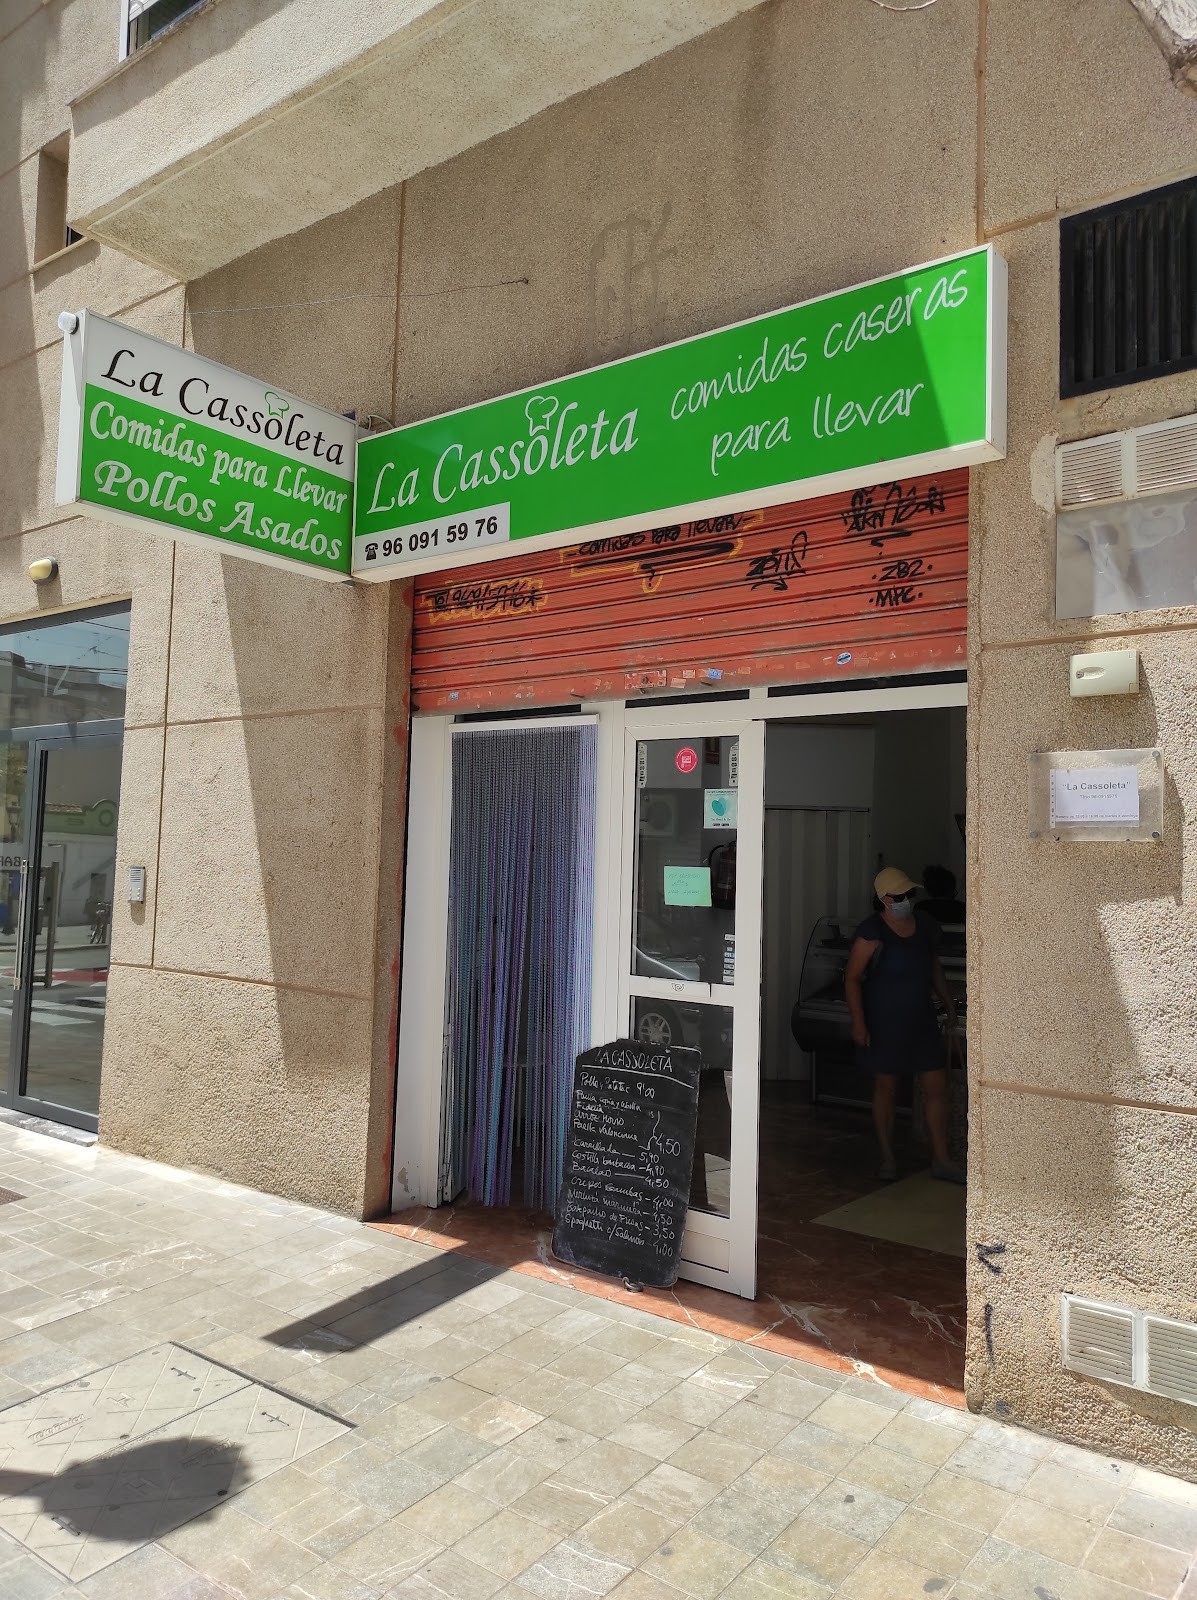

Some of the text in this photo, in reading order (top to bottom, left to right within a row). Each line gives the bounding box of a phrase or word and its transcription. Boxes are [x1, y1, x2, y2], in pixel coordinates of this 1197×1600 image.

[670, 269, 969, 420] comidas caseras
[89, 401, 347, 514] Comidas para Llevar
[100, 349, 345, 465] La Cassoleta
[367, 402, 640, 515] La Cassoleta
[711, 383, 925, 476] para llevar
[94, 461, 342, 561] Pollos Asados
[382, 516, 498, 558] 96 091 59 76
